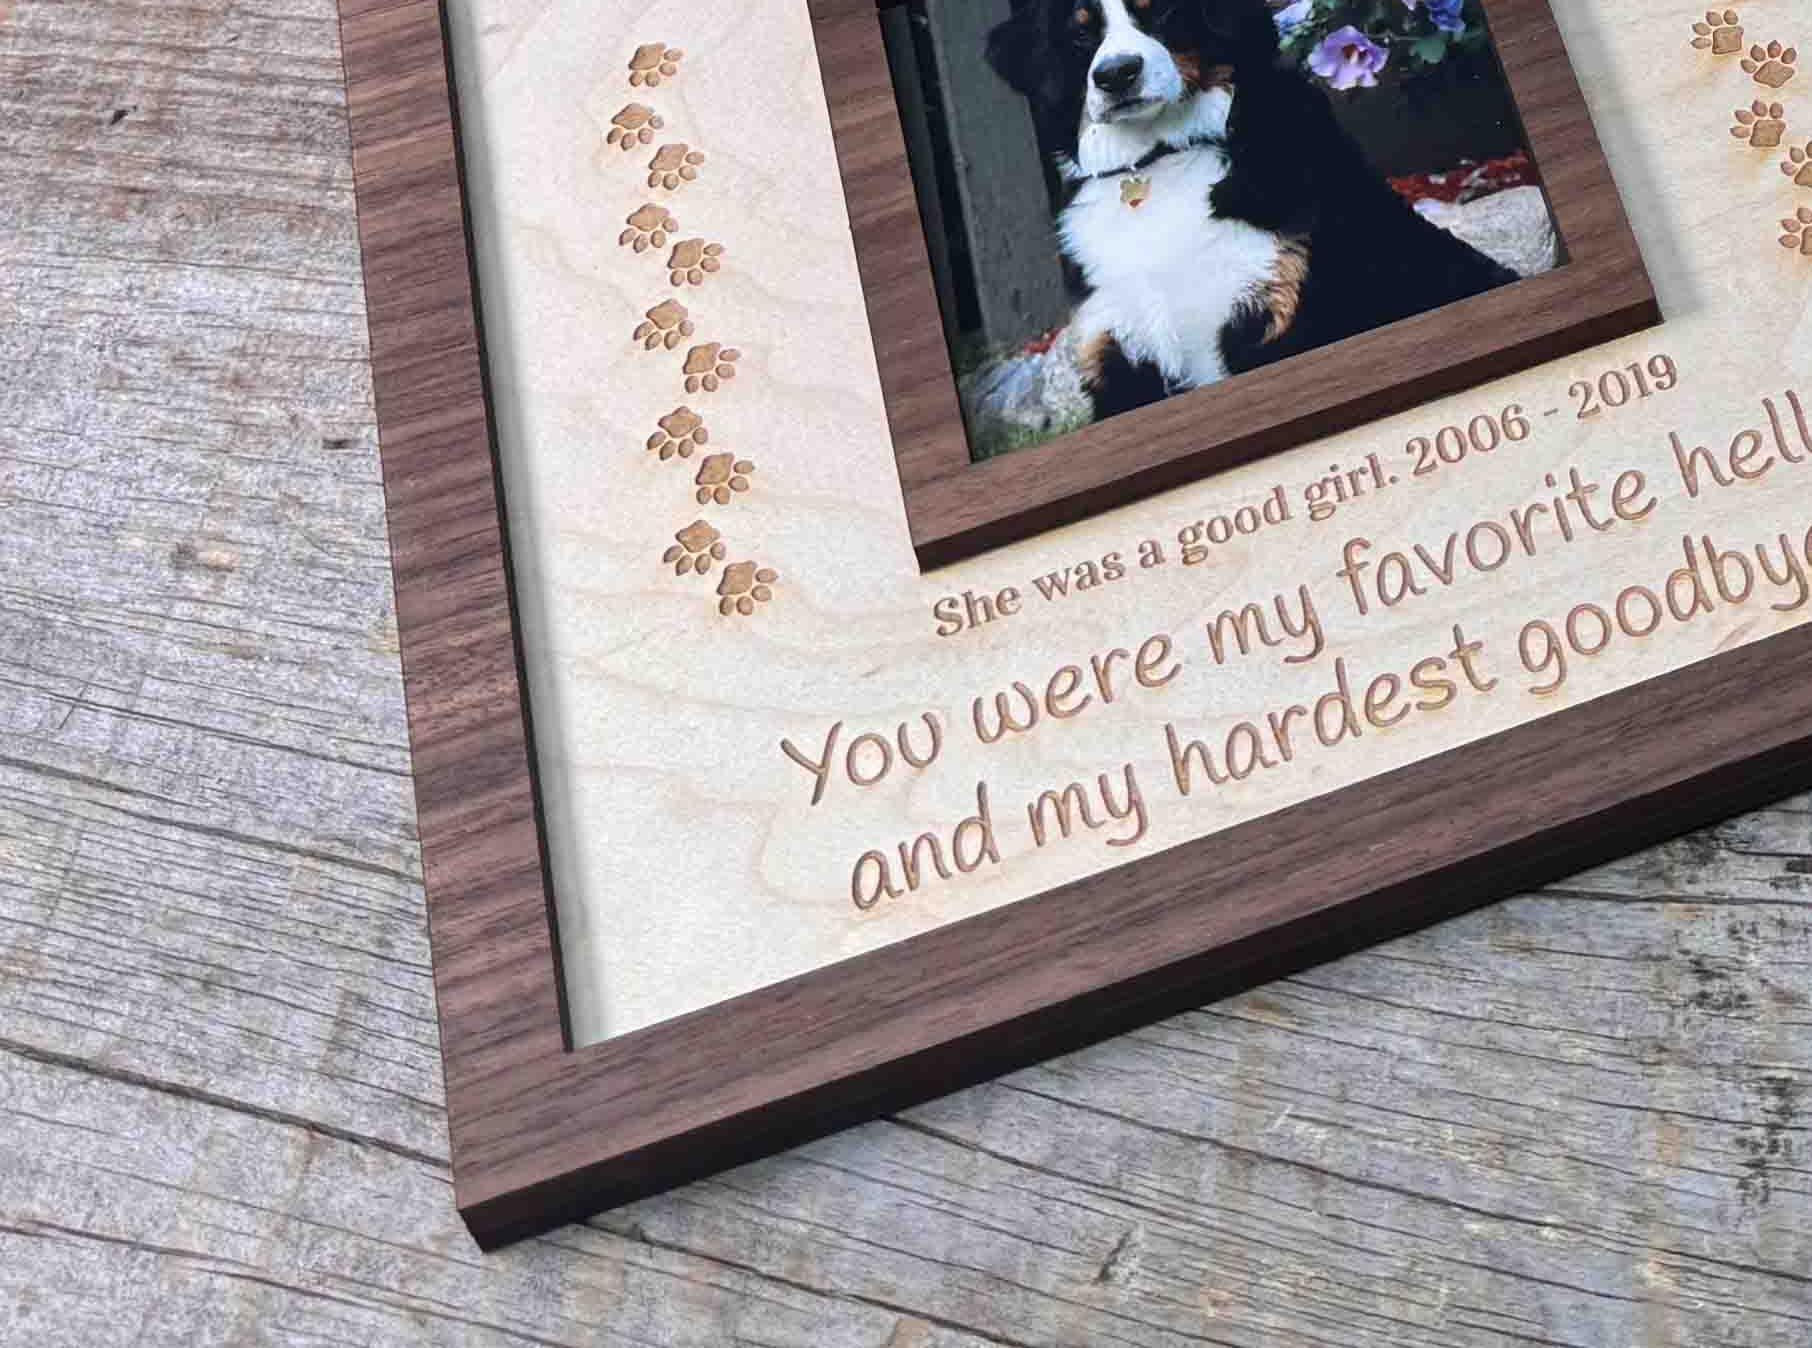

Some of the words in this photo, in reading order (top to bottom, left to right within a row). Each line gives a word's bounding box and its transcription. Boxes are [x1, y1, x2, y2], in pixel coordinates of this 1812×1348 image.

[780, 711, 943, 806] You
[972, 632, 1182, 744] were
[1207, 584, 1325, 664] my
[1337, 468, 1658, 616] favorite
[933, 585, 1021, 636] She
[1032, 546, 1126, 602] was
[1137, 538, 1166, 569] a
[1177, 486, 1289, 566] good
[1303, 453, 1398, 522] girl.
[1406, 404, 1531, 477] 2006
[1568, 353, 1679, 420] 2019
[851, 781, 1001, 911] and
[1027, 763, 1150, 848] my
[1165, 624, 1498, 796] hardest
